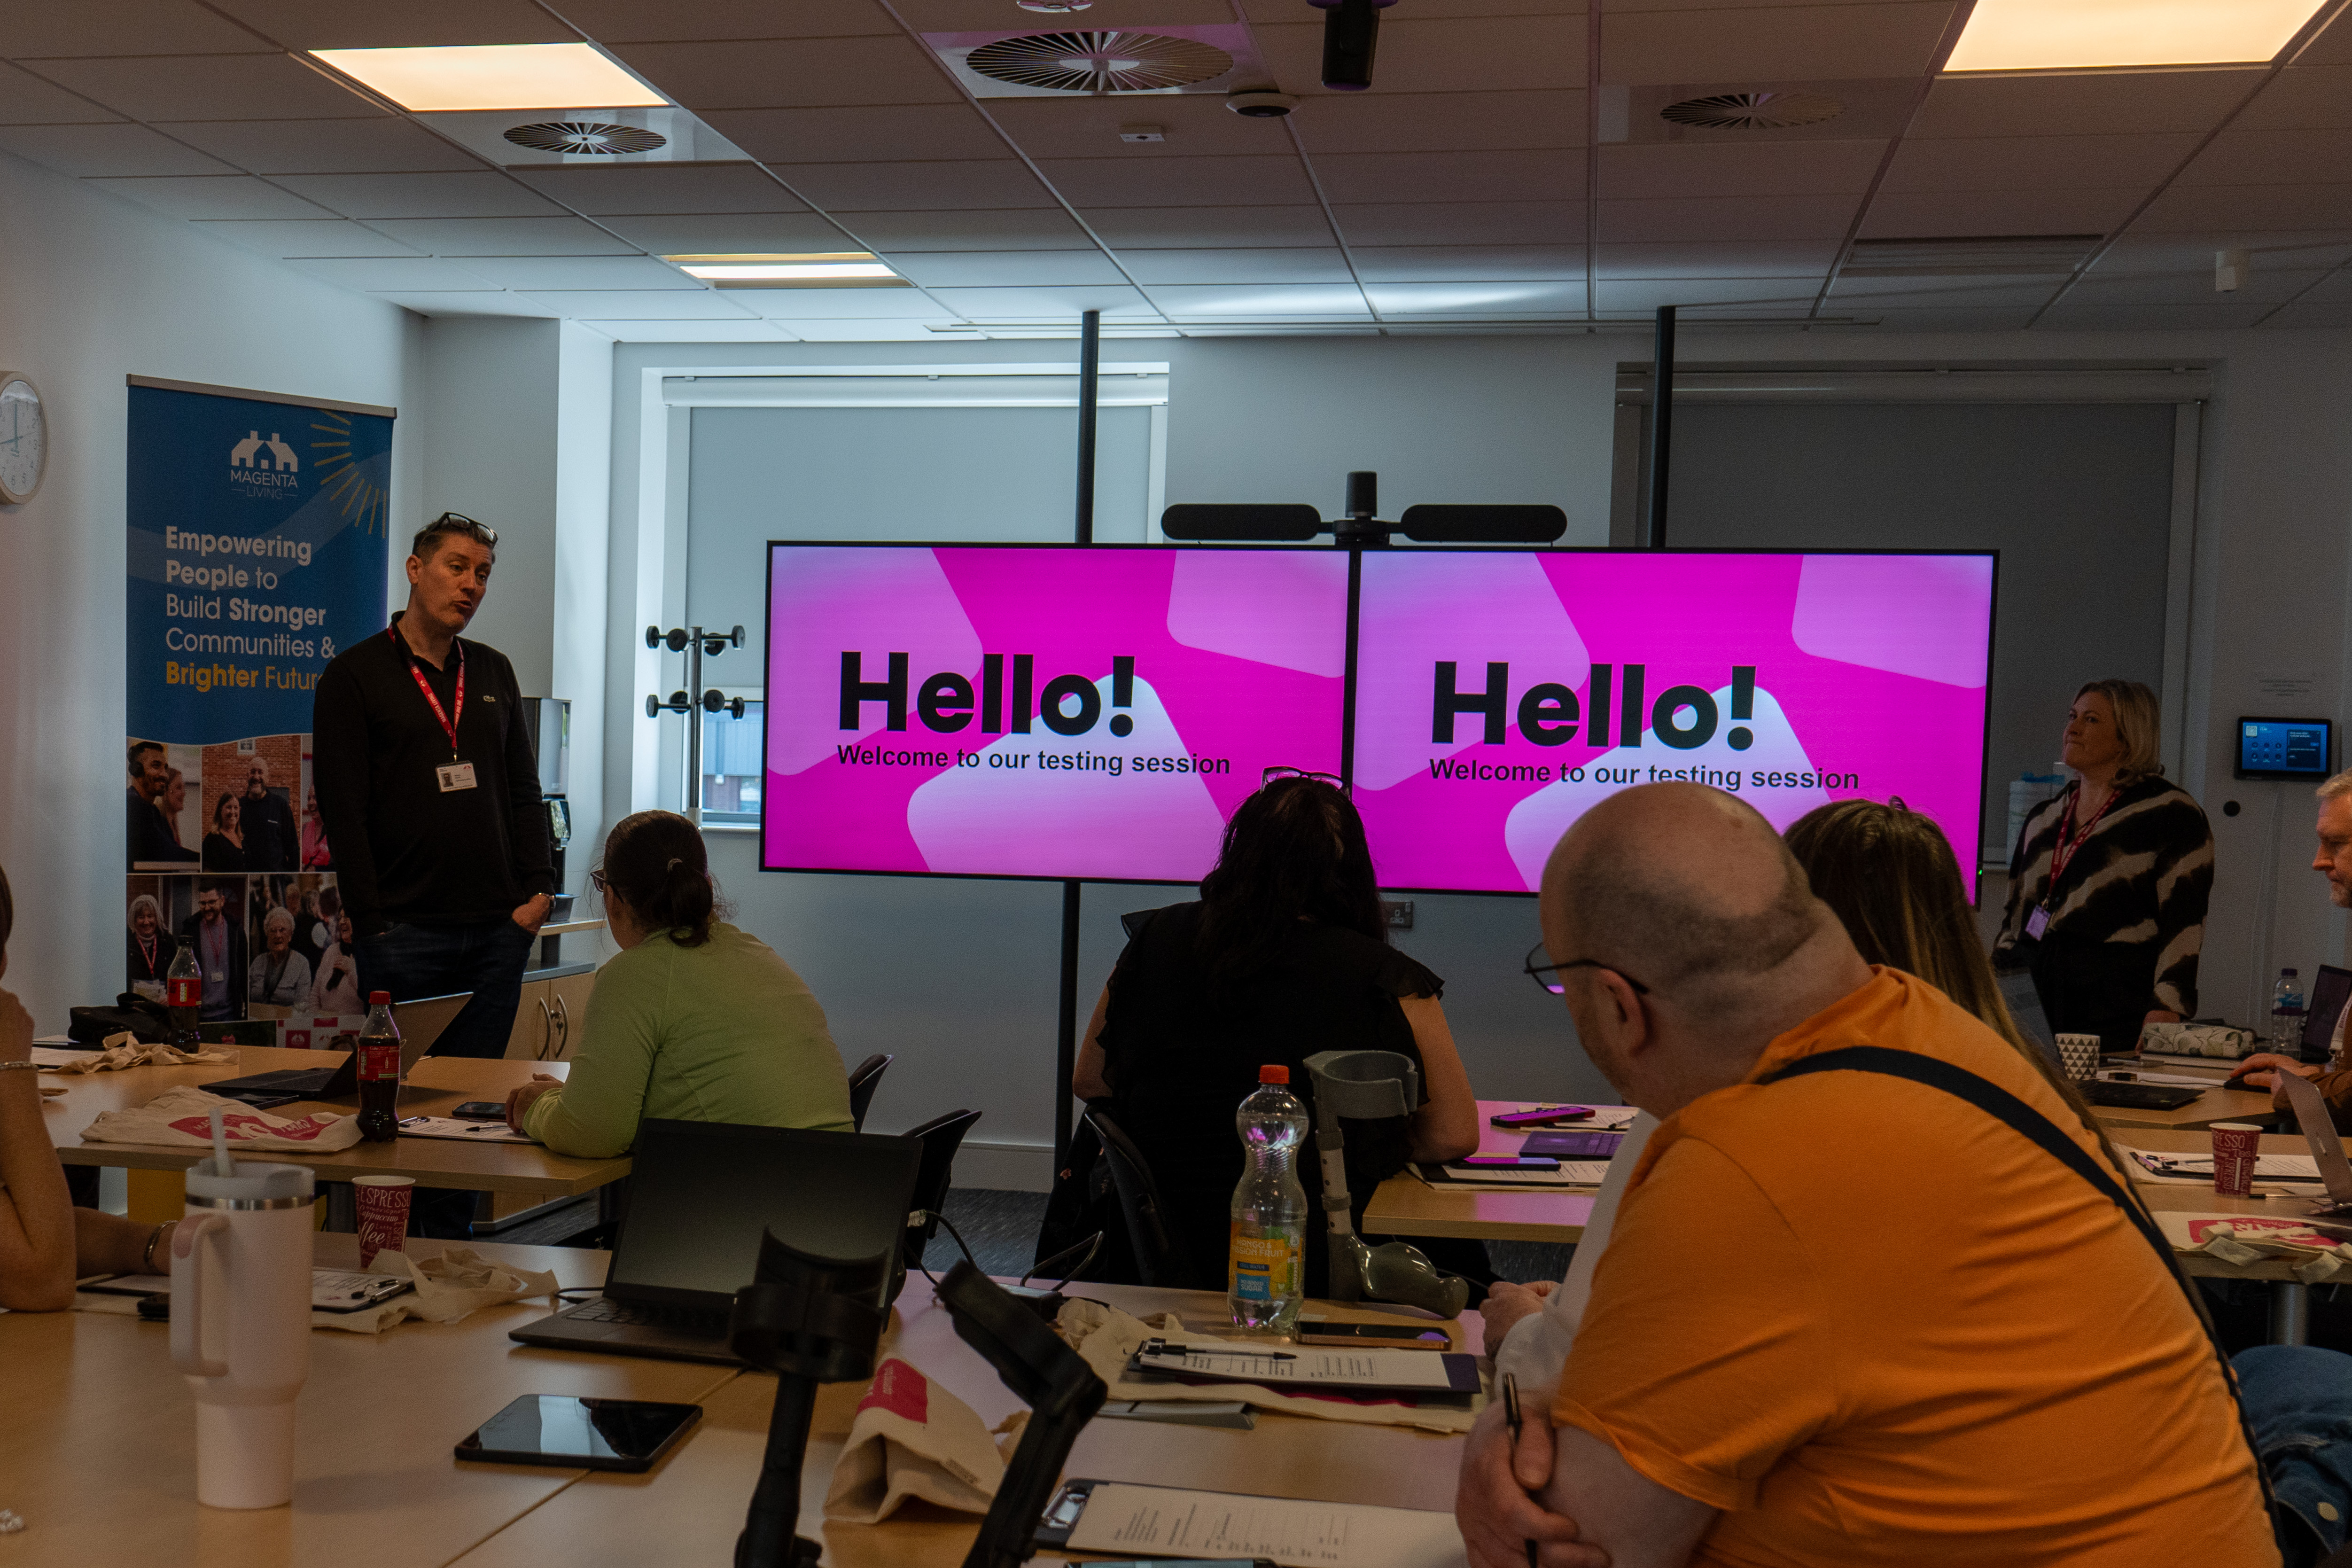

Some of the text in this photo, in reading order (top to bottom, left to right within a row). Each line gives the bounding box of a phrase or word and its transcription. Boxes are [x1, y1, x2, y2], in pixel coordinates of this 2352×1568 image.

[231, 468, 298, 488] MAGENTA
[247, 485, 283, 499] LIVING
[165, 525, 312, 567] Empowering
[165, 559, 278, 592] People to
[166, 593, 327, 632] Build Stronger
[165, 626, 336, 659] Communities &
[166, 661, 259, 693] Brighter
[839, 651, 1135, 737] Hello!
[1431, 661, 1757, 751] Hello!
[837, 744, 1231, 776] Welcome to our testing session
[1429, 758, 1860, 791] Welcome to our testing session
[2223, 1157, 2236, 1190] ESPRESSO
[359, 1204, 399, 1222] Cappuccino
[360, 1186, 412, 1208] ESPRESSO
[1236, 1239, 1265, 1249] MANGO
[1259, 1248, 1284, 1257] FRUIT
